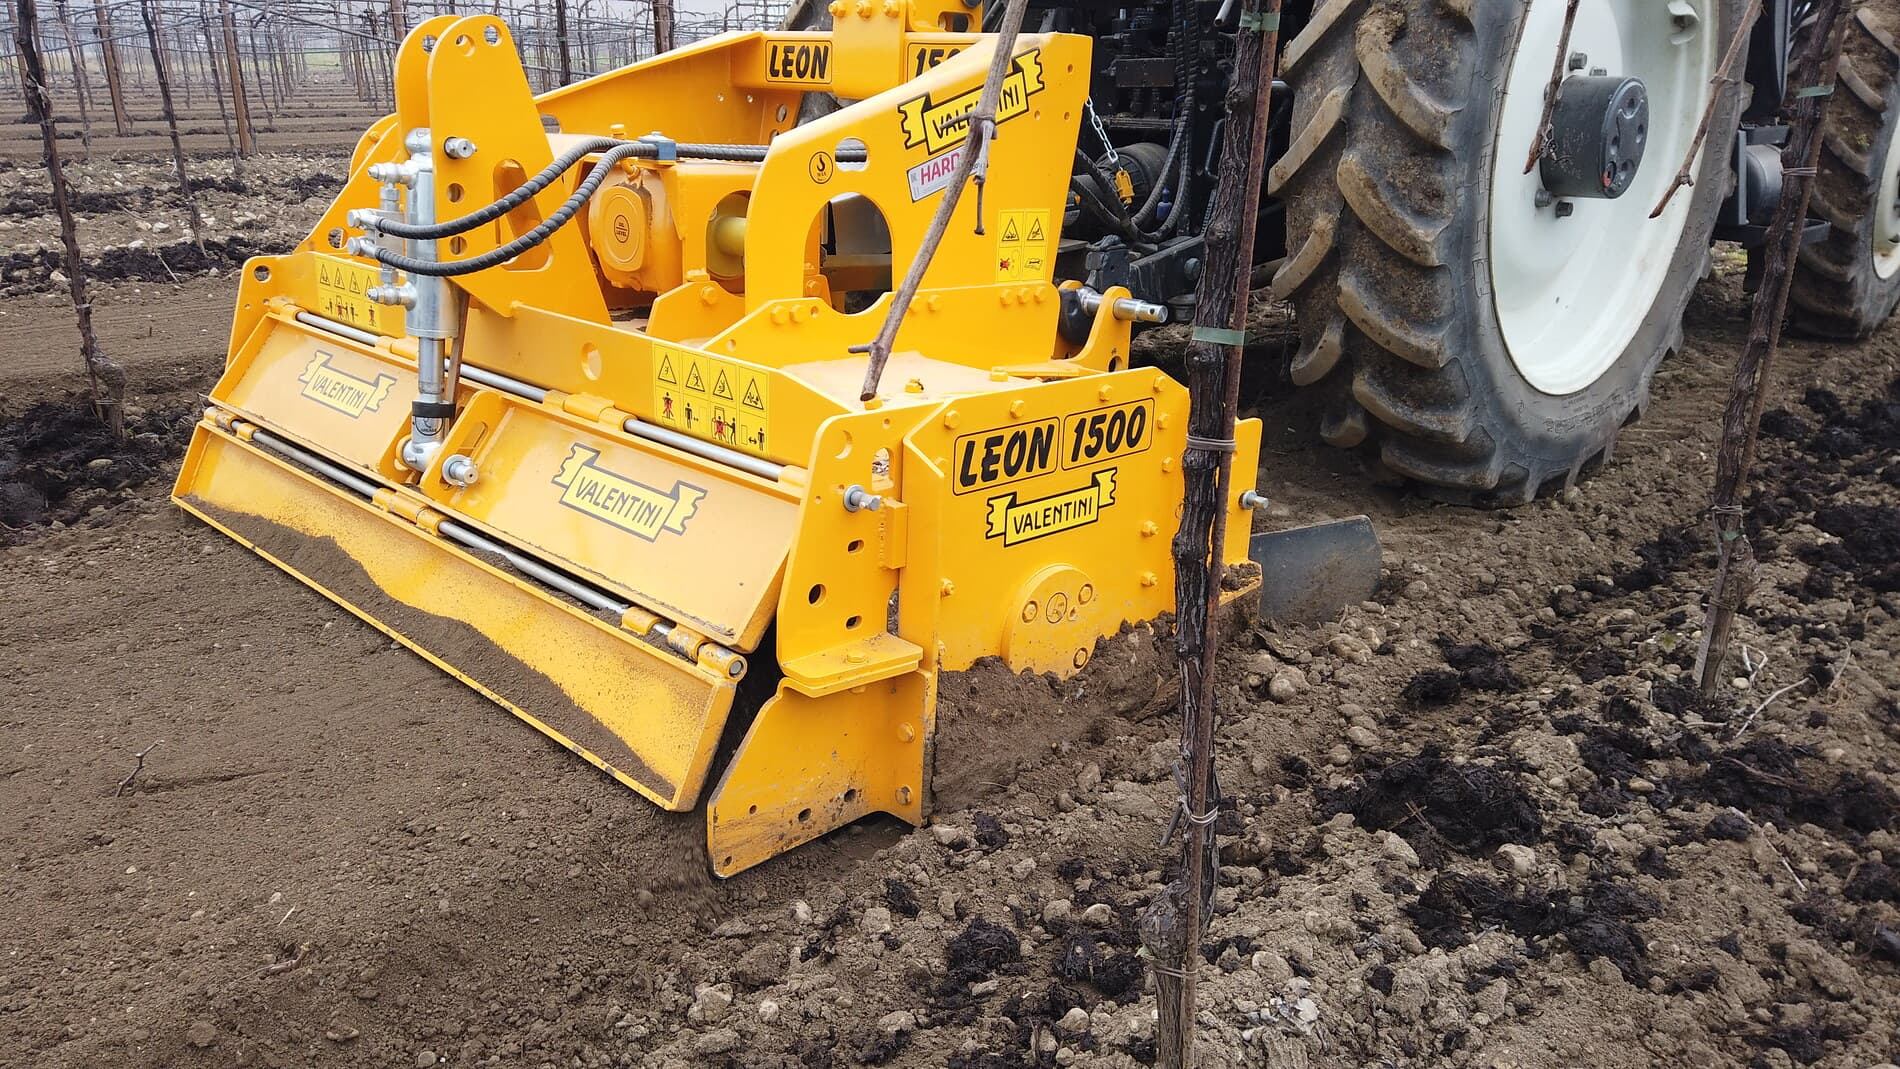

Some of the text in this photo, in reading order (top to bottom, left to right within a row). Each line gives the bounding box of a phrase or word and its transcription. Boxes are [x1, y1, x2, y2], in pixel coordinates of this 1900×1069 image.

[769, 45, 829, 79] LEON
[932, 84, 1020, 140] VALEINI
[312, 374, 368, 409] VALENTINI
[959, 405, 1147, 488] LEON 1500
[575, 476, 663, 529] VALENTINI
[1013, 496, 1093, 535] VALENTINI
